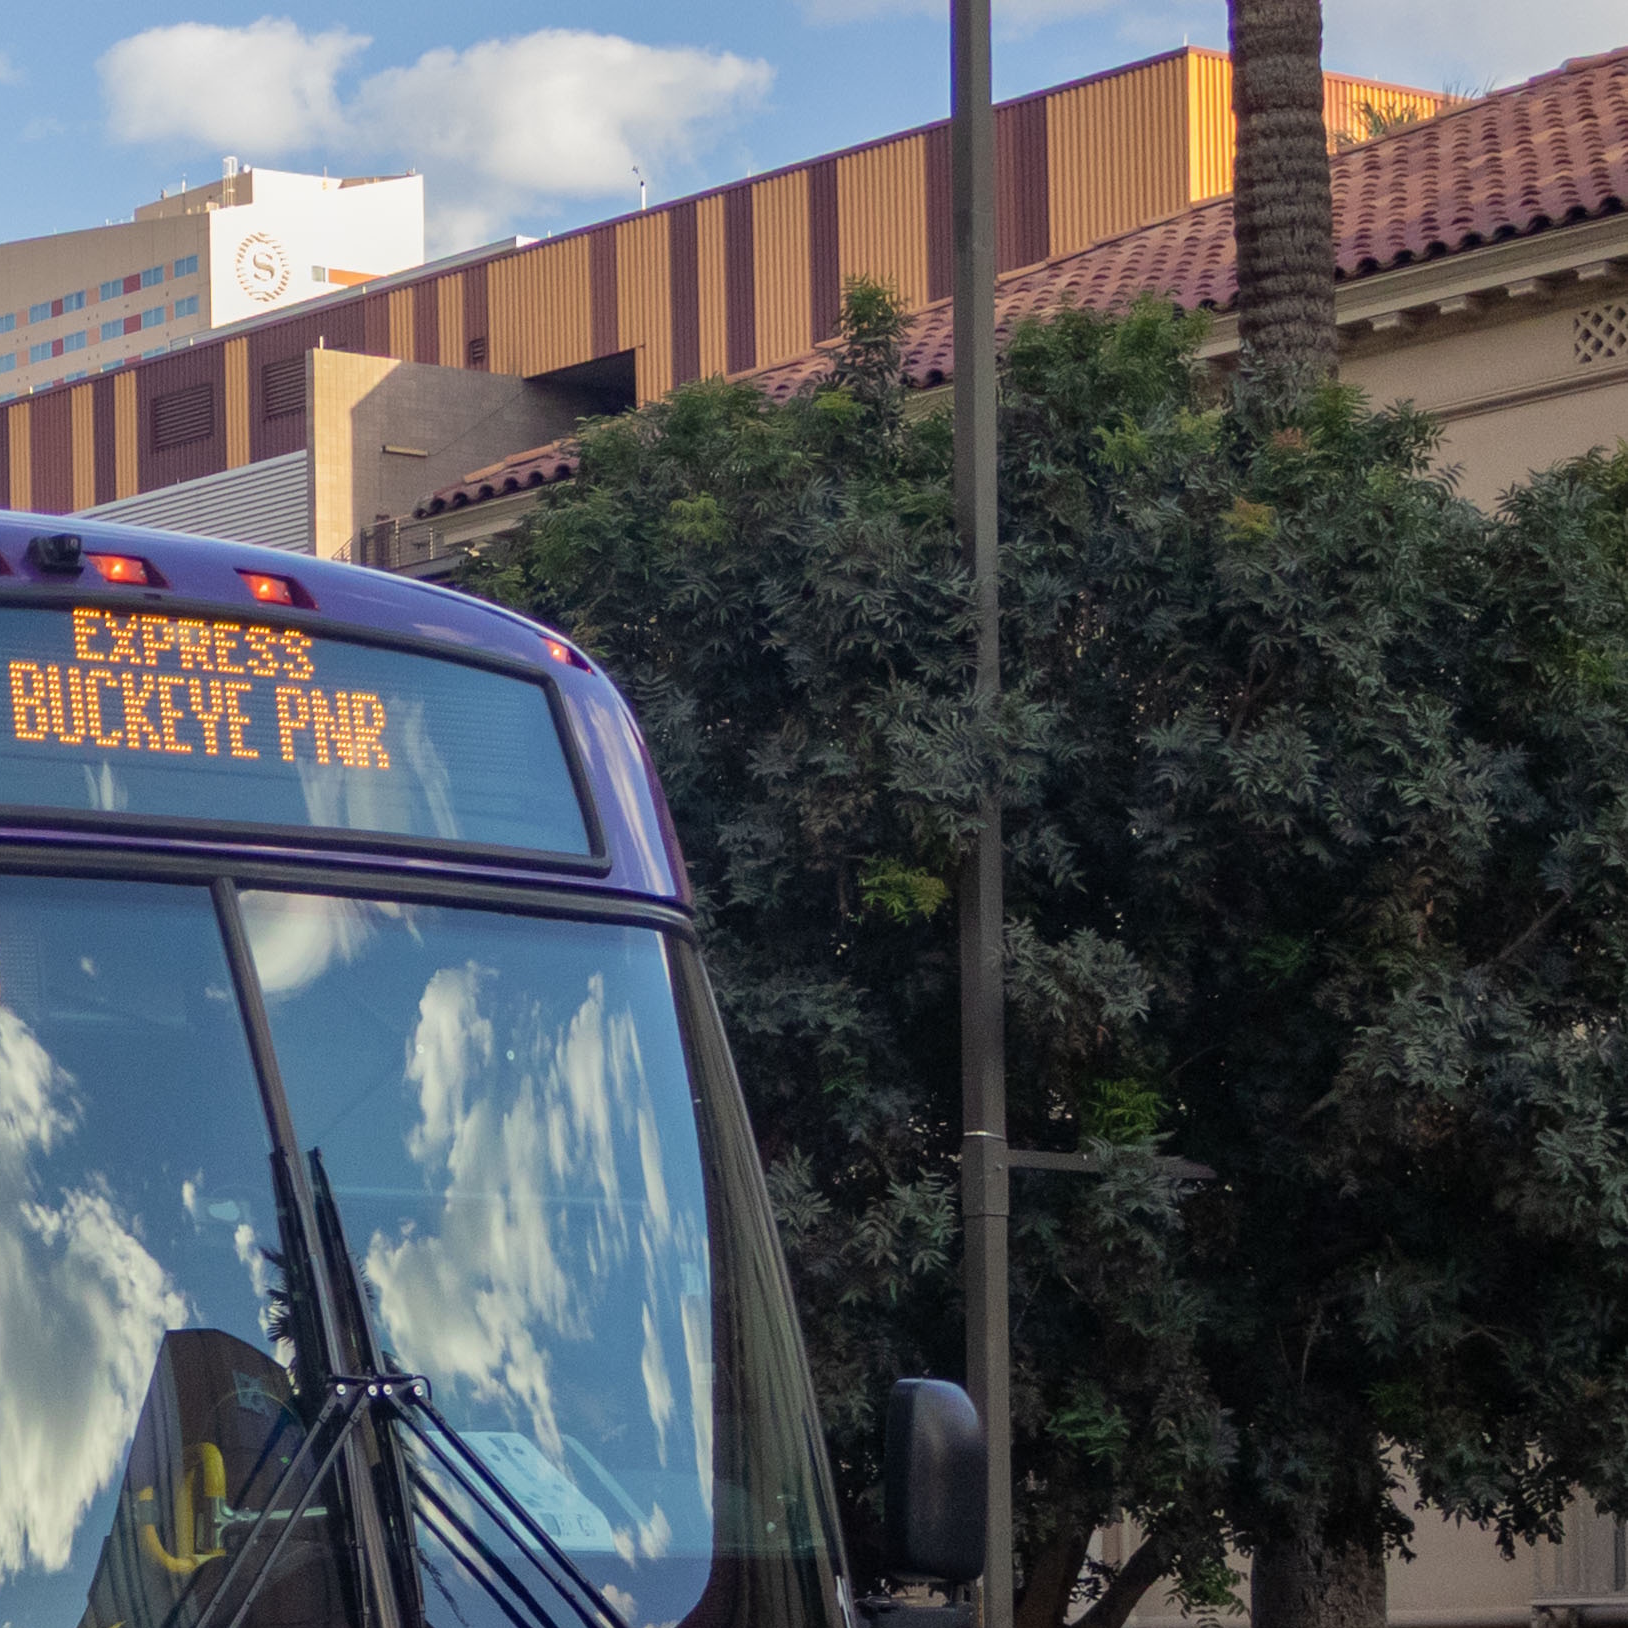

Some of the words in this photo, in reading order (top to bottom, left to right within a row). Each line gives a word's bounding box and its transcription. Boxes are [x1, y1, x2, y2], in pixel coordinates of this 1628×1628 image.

[73, 608, 315, 680] EXPRESS
[9, 660, 260, 760] BUCKEYE
[275, 686, 390, 770] PNR
